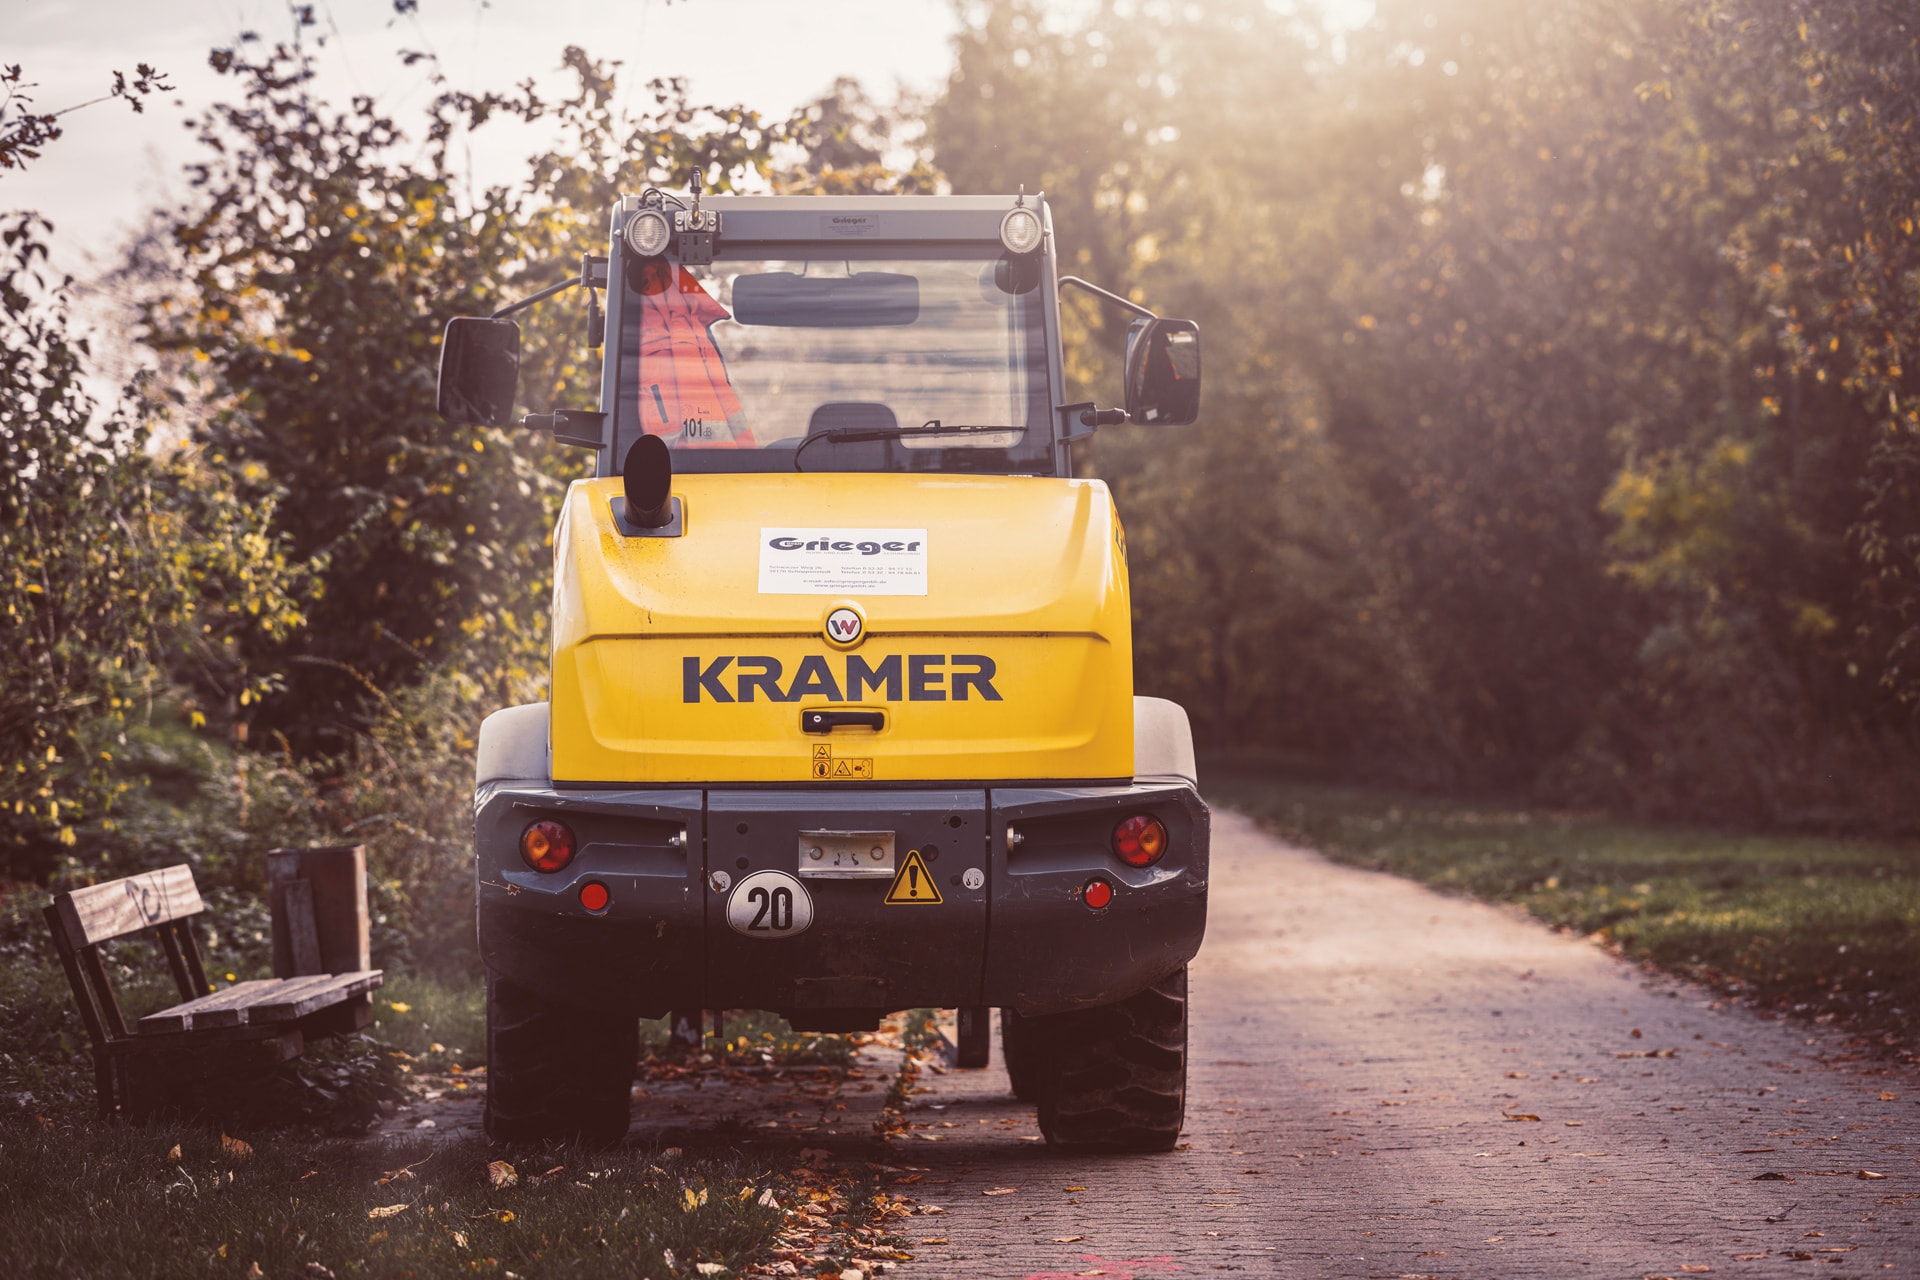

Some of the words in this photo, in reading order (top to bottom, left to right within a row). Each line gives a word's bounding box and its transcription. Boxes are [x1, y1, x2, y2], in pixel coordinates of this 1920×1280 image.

[683, 418, 702, 437] 101
[769, 537, 920, 555] Grieger
[682, 654, 1004, 703] KRAMER
[747, 886, 793, 931] 20
